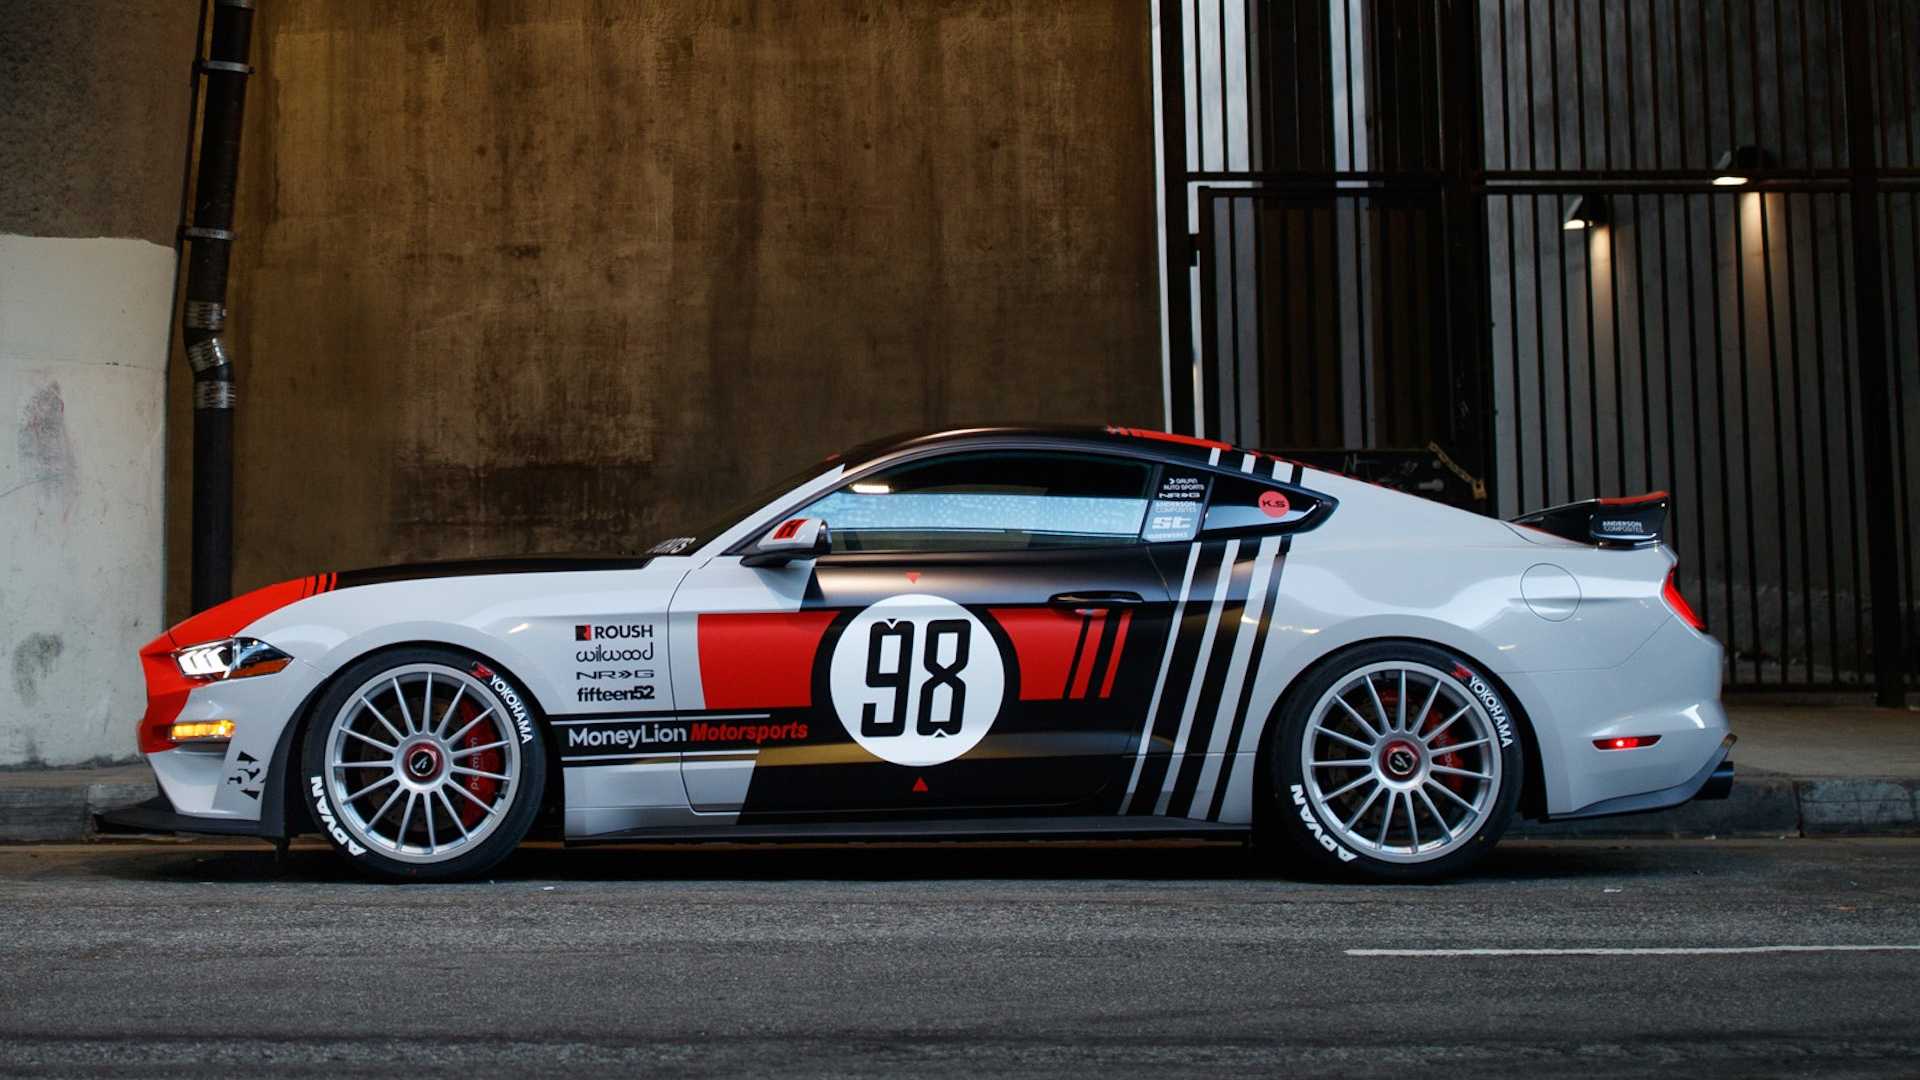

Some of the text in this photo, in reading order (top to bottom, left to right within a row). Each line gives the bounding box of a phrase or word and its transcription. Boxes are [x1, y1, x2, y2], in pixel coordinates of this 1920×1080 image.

[576, 641, 654, 662] wilwood
[594, 624, 654, 639] ROUSH
[488, 674, 535, 745] YOKOHAMA
[577, 685, 655, 702] fifteen52
[861, 618, 972, 738] 98
[1469, 675, 1514, 749] YOKOHAMA
[568, 720, 808, 749] MoneyLion Motorsports
[310, 776, 367, 857] ADVAN
[1290, 784, 1358, 862] ADVAN
